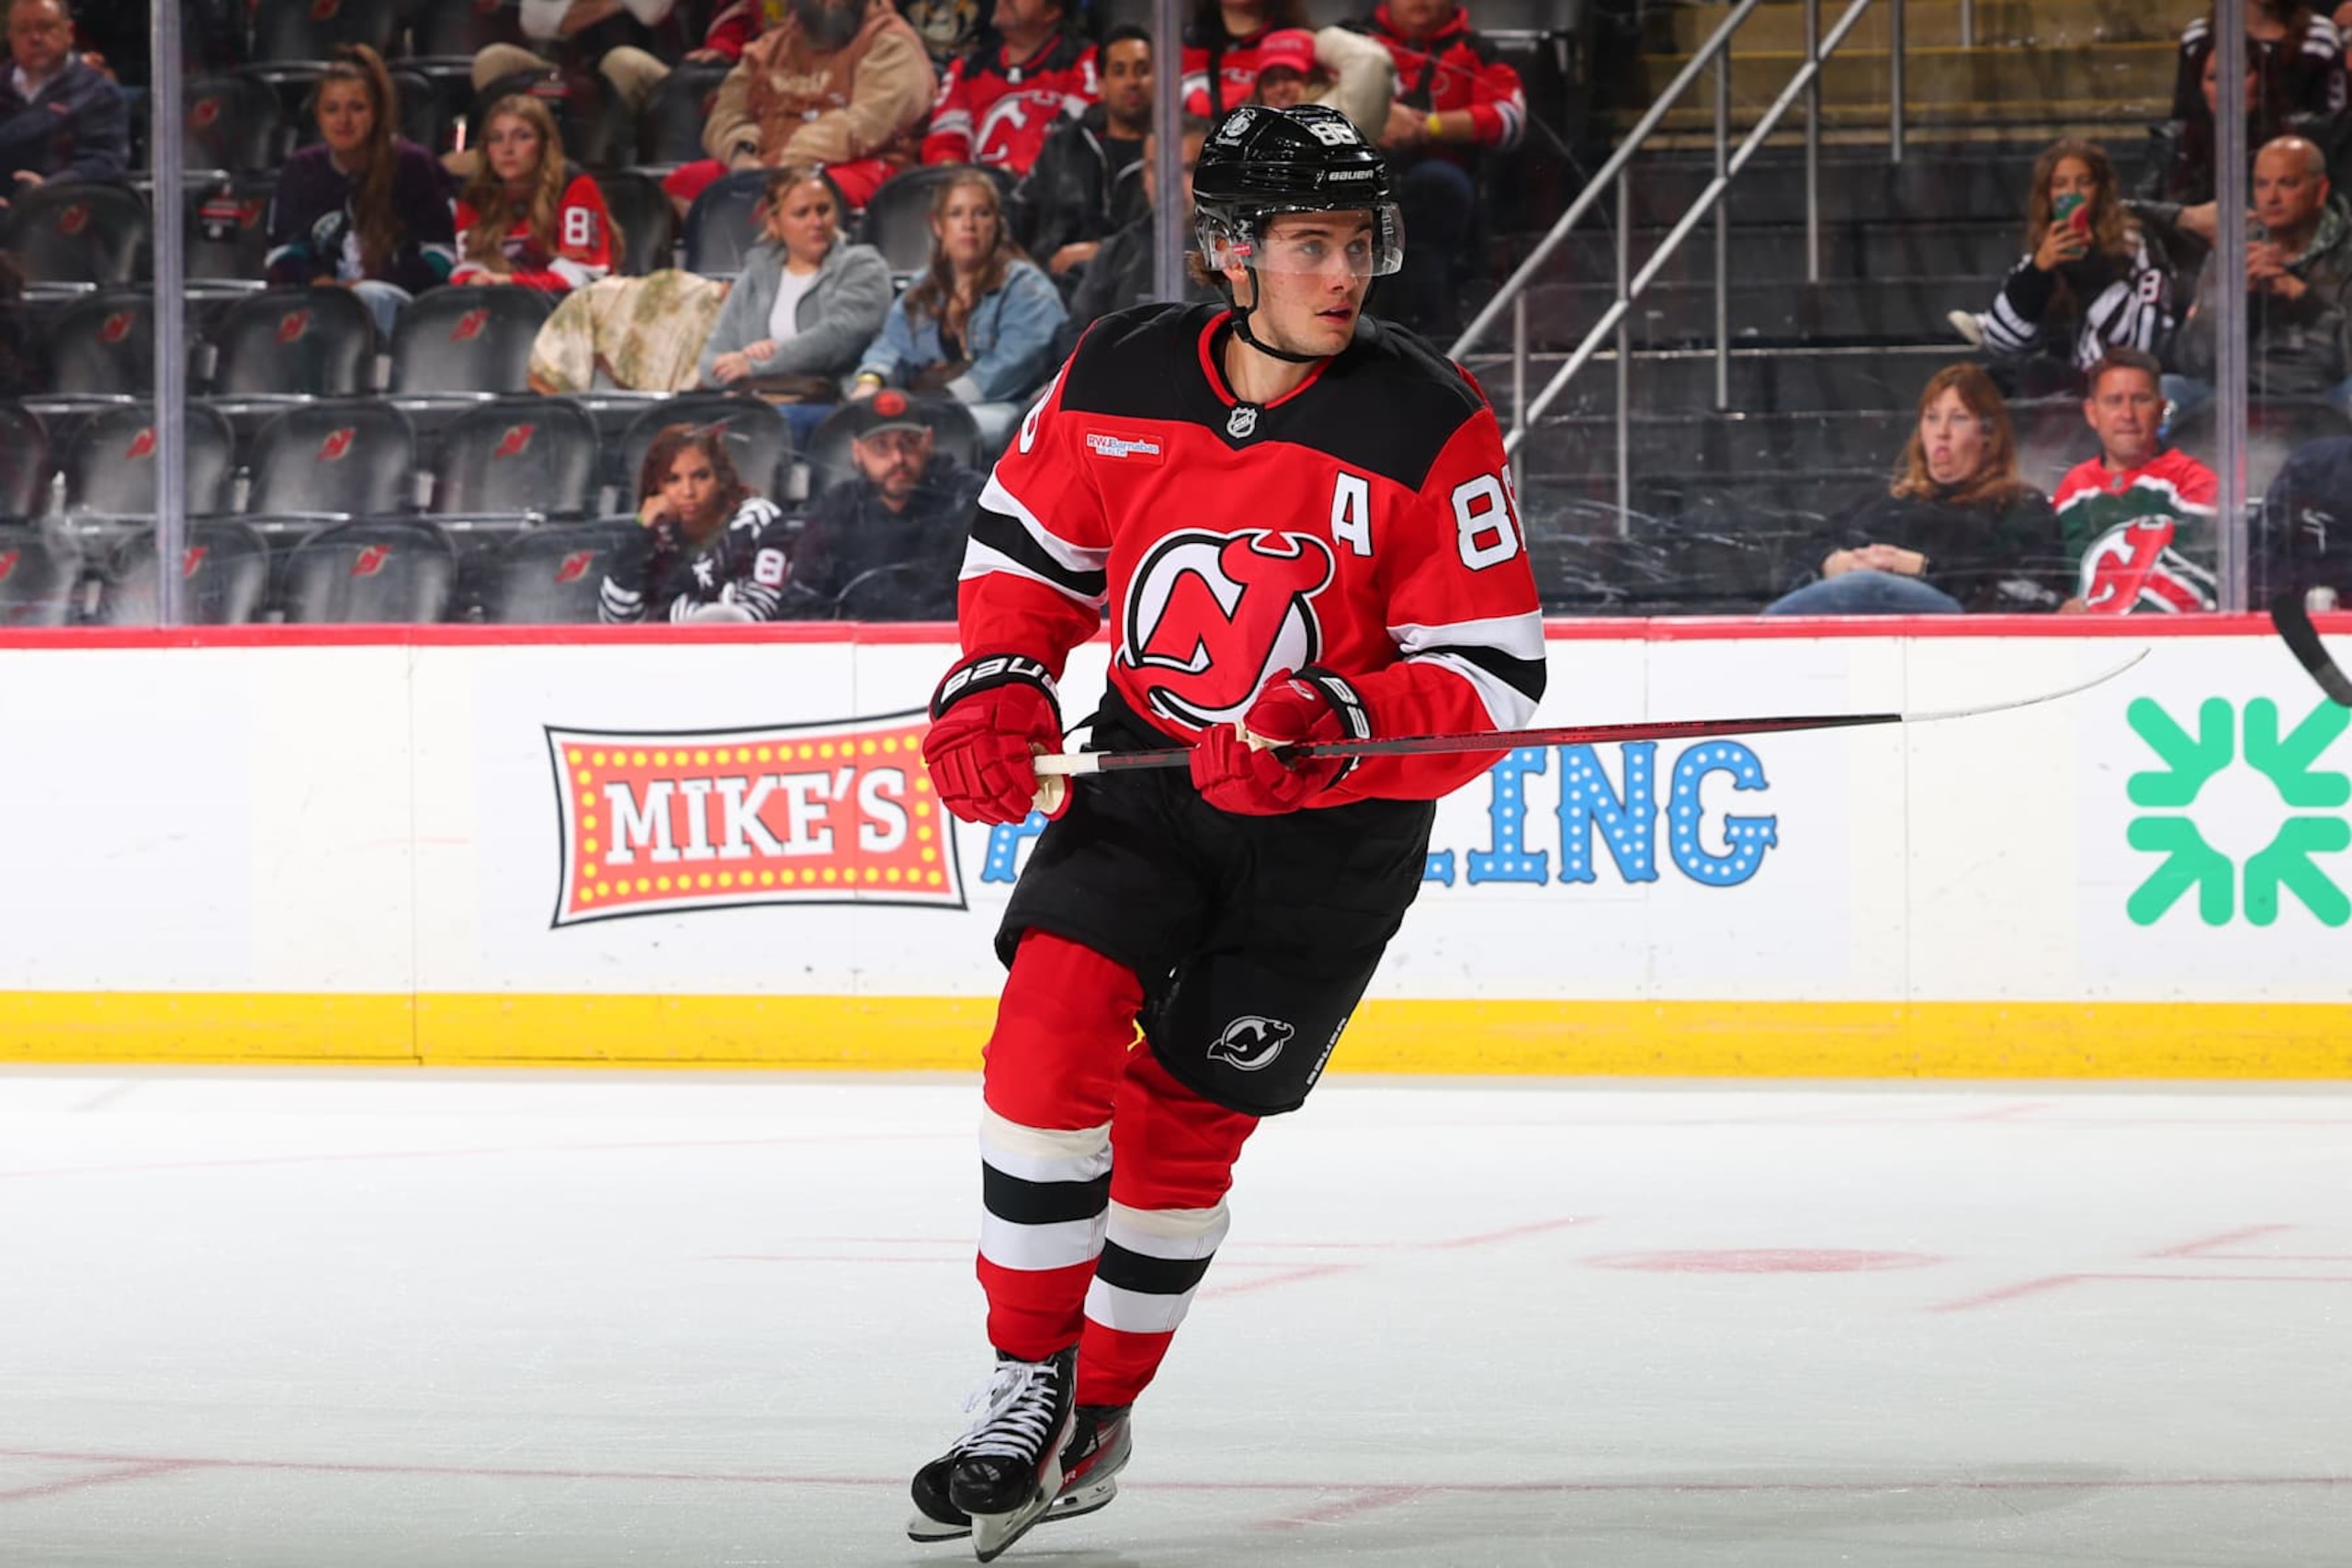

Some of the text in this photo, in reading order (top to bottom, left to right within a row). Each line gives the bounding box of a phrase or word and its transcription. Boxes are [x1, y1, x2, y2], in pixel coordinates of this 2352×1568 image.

[1329, 169, 1374, 182] BAUER
[1331, 470, 1373, 557] A
[604, 766, 908, 865] MIKE'S
